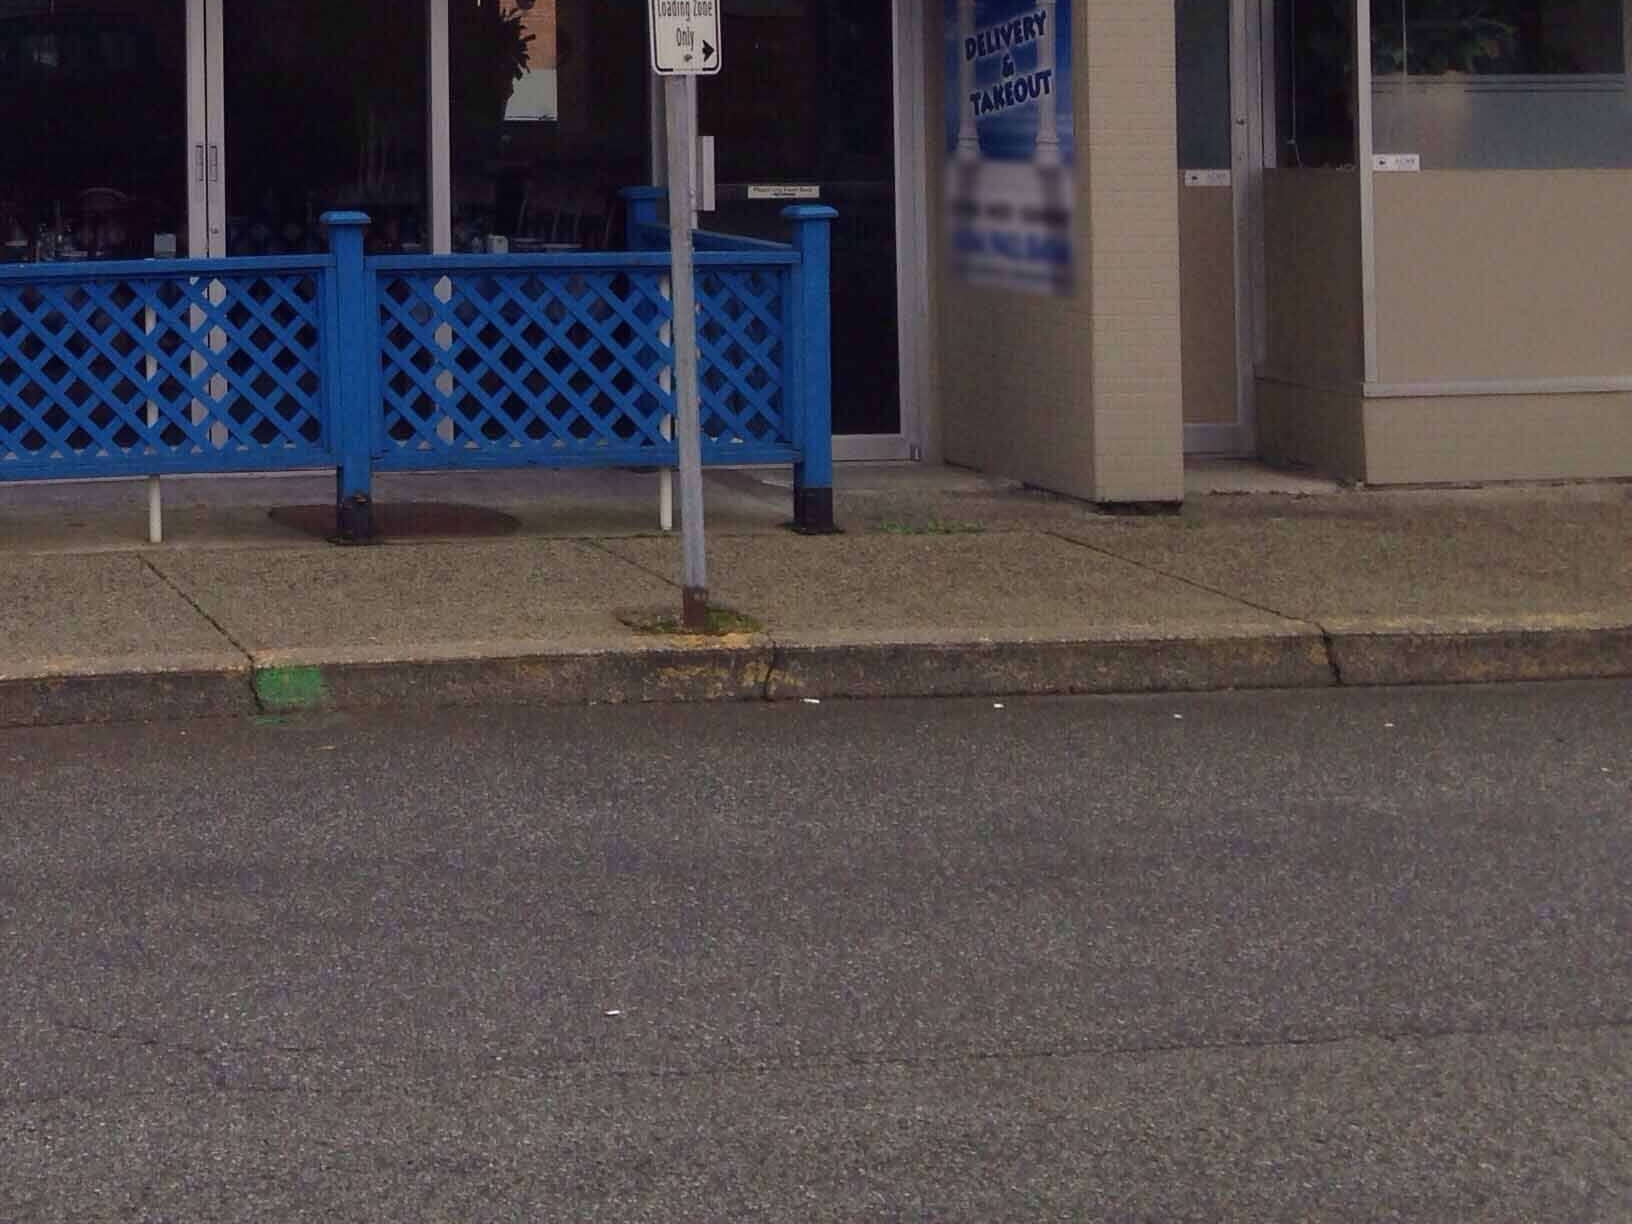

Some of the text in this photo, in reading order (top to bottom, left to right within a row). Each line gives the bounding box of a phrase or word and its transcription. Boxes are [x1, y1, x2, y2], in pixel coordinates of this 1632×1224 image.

[676, 27, 695, 50] Only
[965, 10, 1047, 61] DELIVERY
[969, 69, 1052, 115] TAKEOUT
